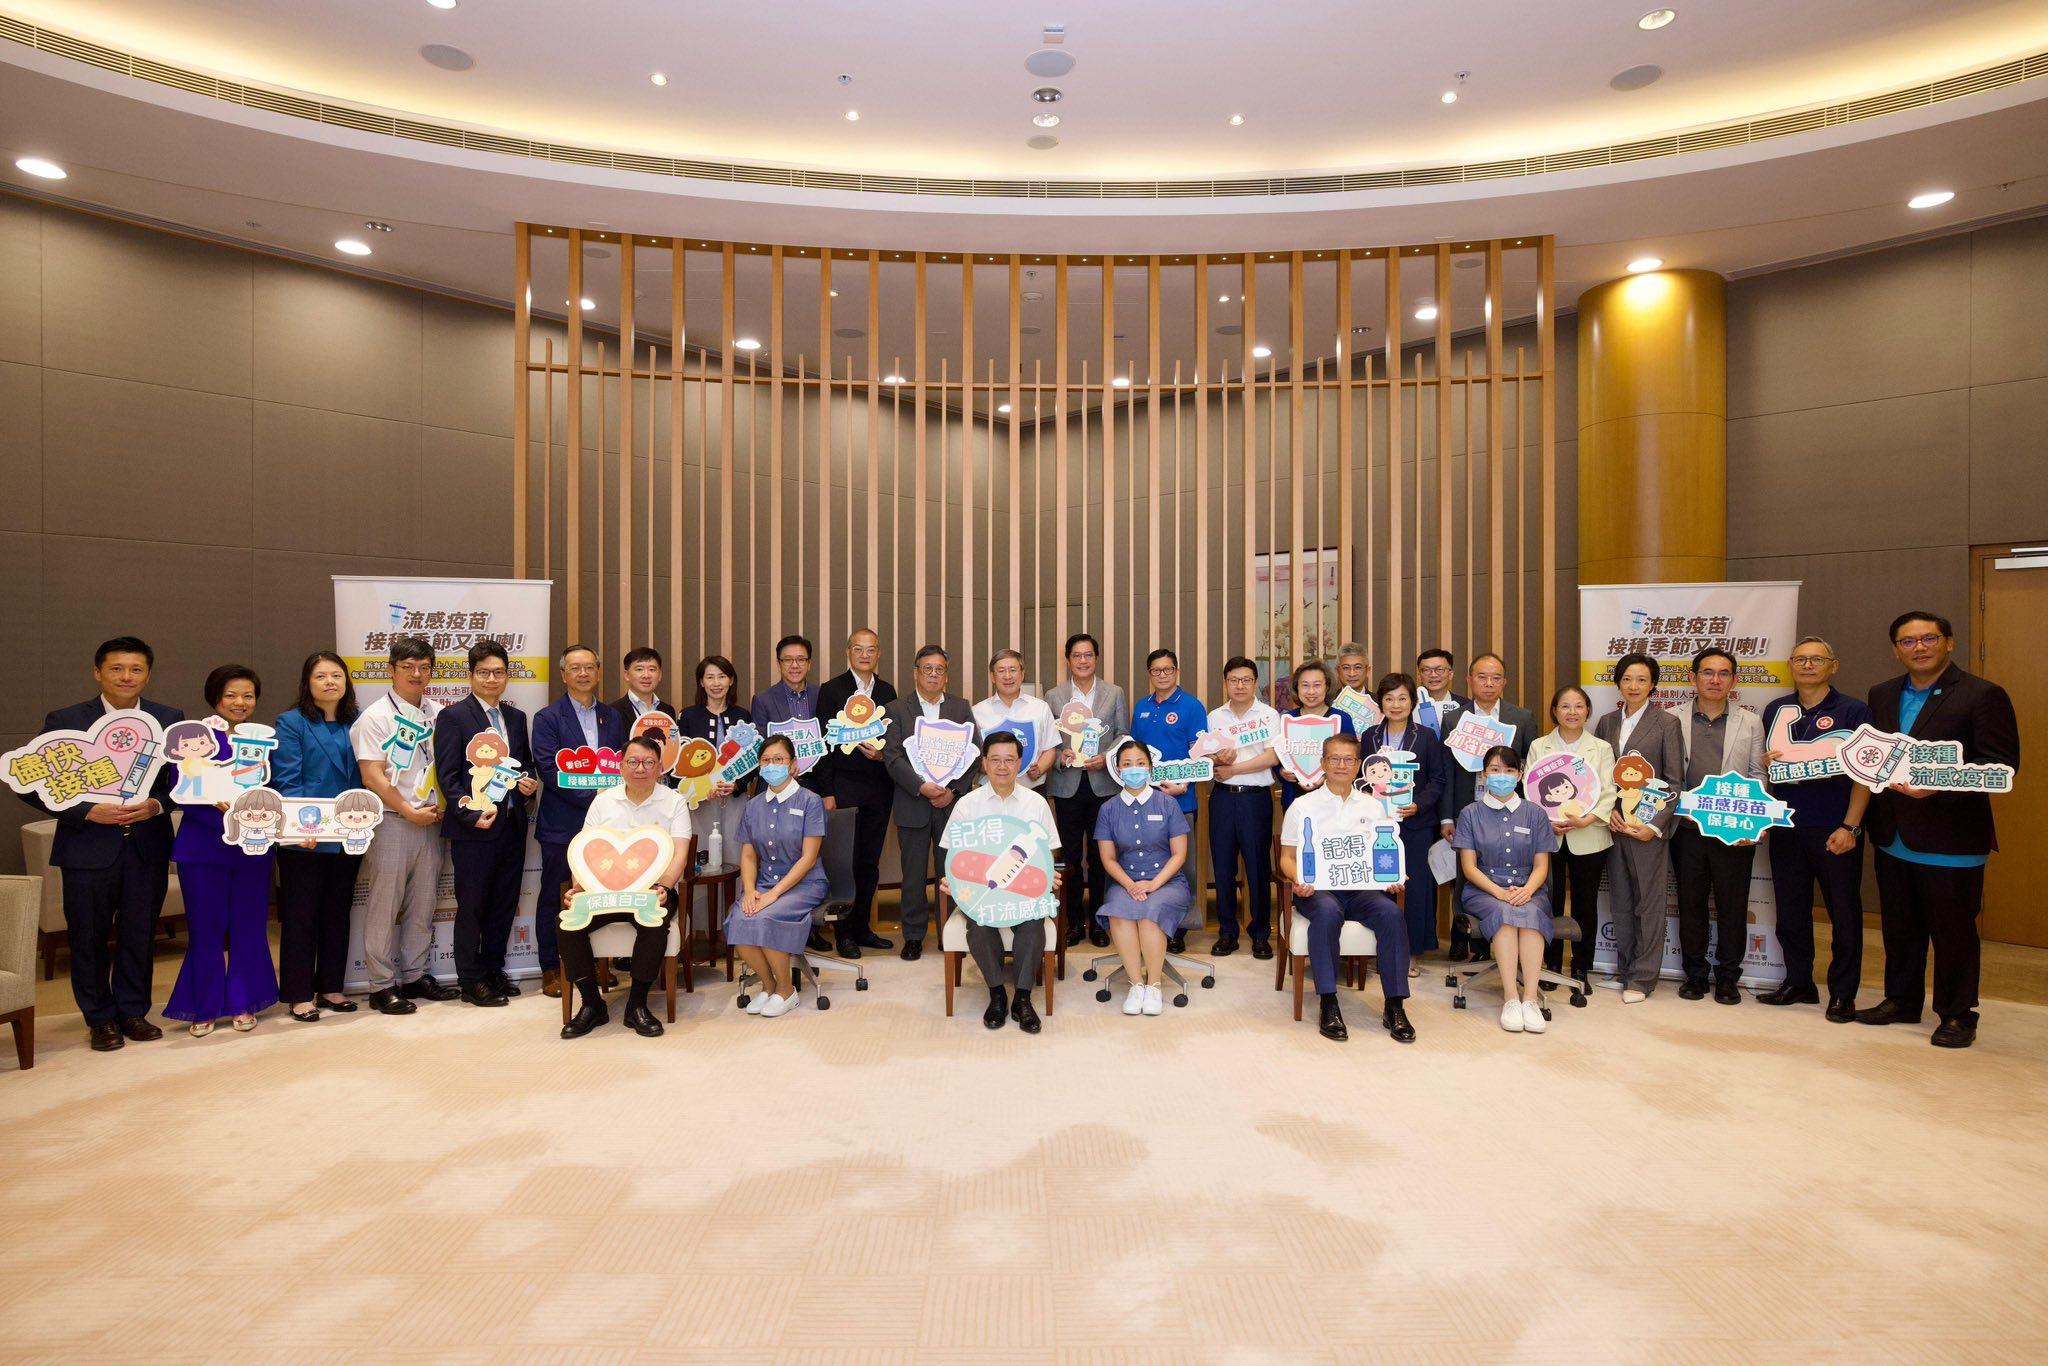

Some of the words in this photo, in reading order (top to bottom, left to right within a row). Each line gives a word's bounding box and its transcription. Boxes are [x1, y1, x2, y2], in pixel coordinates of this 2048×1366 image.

[403, 611, 489, 630] 流感疫苗
[1642, 616, 1730, 635] 流感疫苗
[1229, 718, 1267, 735] 愛己愛人
[1239, 728, 1270, 744] 快打針
[1909, 743, 1958, 765] 接種
[44, 756, 122, 804] 接種
[1151, 761, 1209, 782] 接種疫苗
[1908, 767, 2009, 789] 流感疫苗
[1715, 781, 1750, 798] 接種
[1697, 795, 1767, 815] 流感疫苗
[1707, 813, 1754, 830] 保身心
[950, 818, 1004, 848] 記得
[1321, 834, 1366, 860] 記得
[1328, 860, 1373, 887] 打針
[587, 893, 648, 909] 保護自己
[977, 896, 1059, 923] 打流感針
